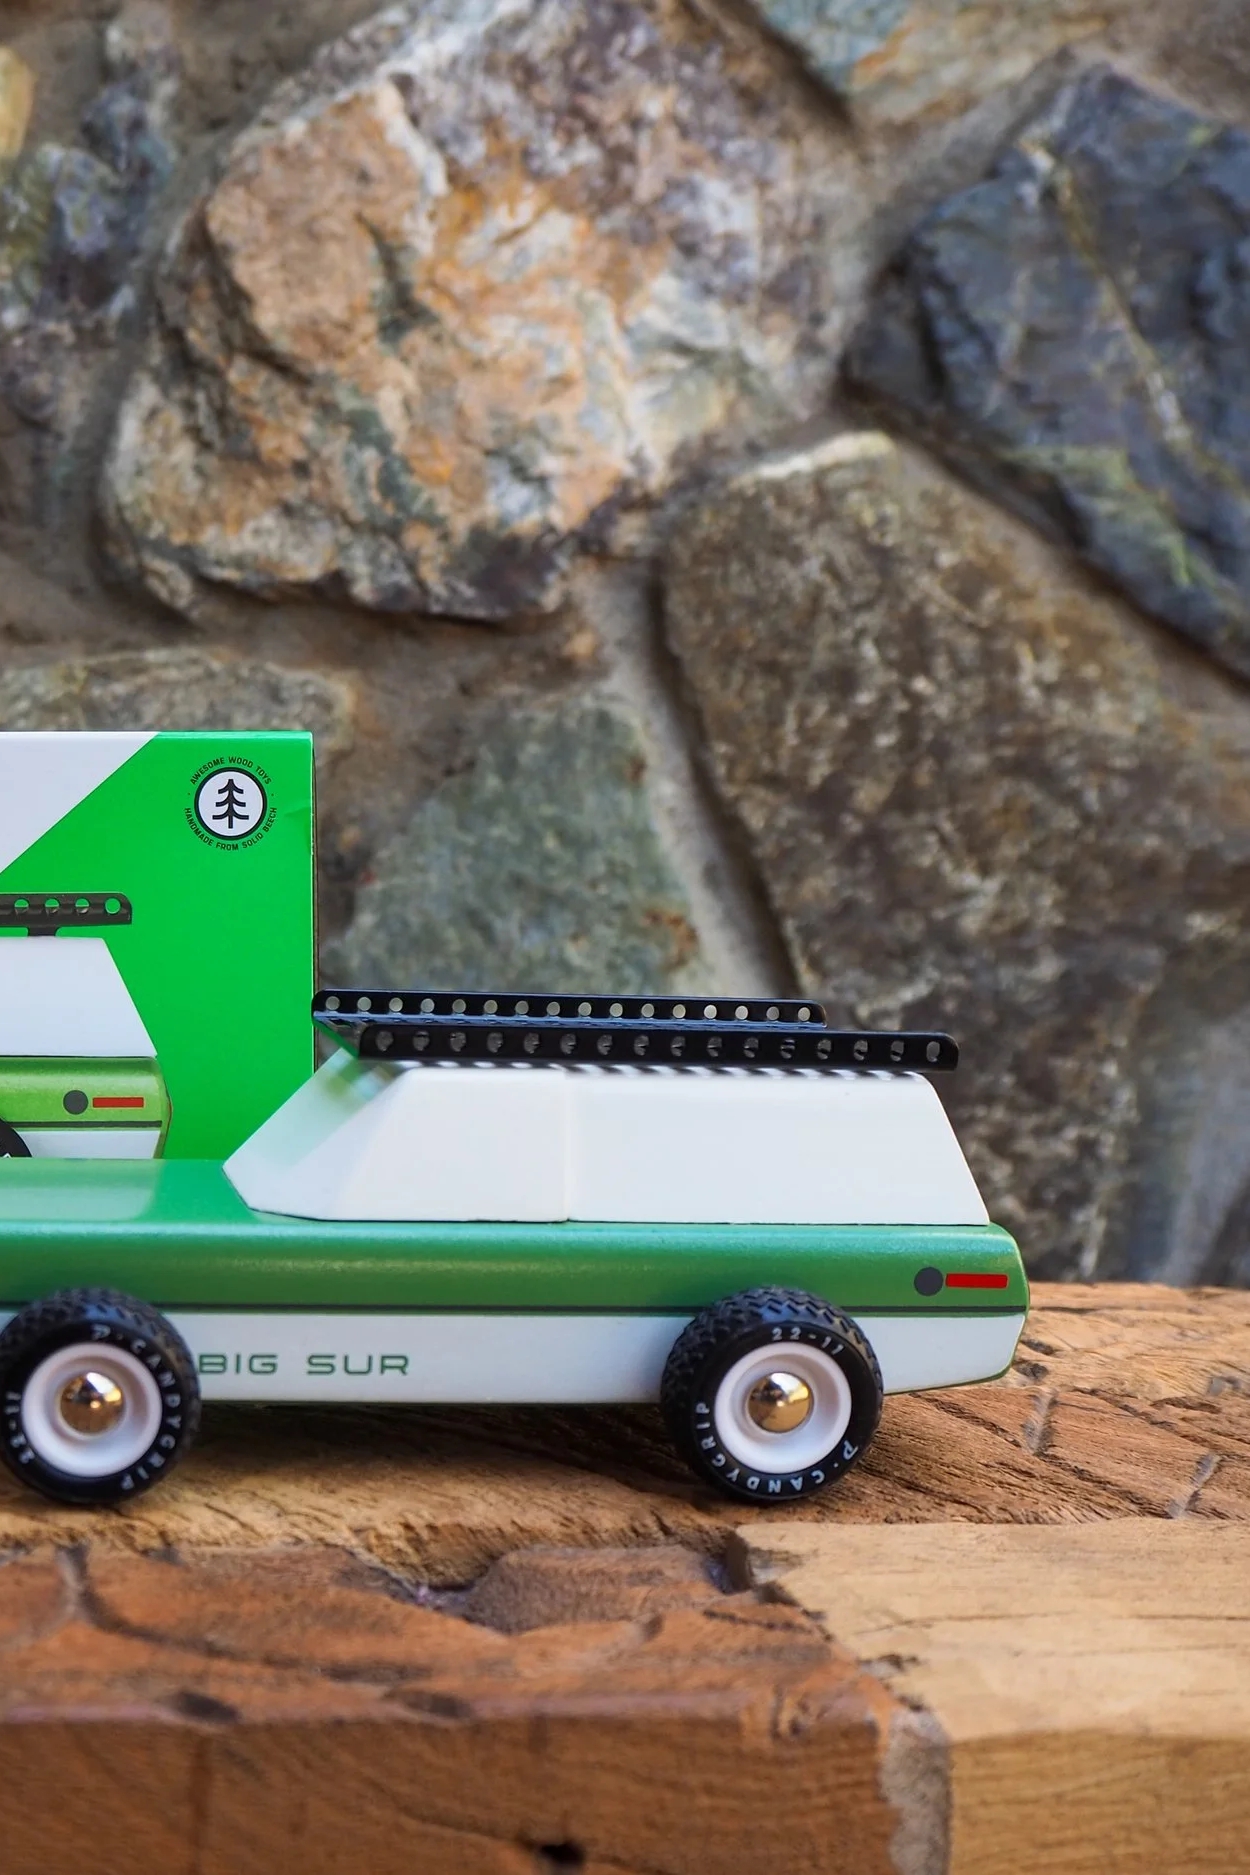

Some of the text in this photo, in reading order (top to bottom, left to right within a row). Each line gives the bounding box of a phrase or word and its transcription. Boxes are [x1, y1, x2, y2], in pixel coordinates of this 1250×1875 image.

[190, 756, 272, 785] AWESOME WOOD TOYS
[184, 807, 277, 851] HANDMADE FROM SOLID BEECH
[771, 1327, 844, 1355] 22-11
[198, 1353, 409, 1376] BIG SUR
